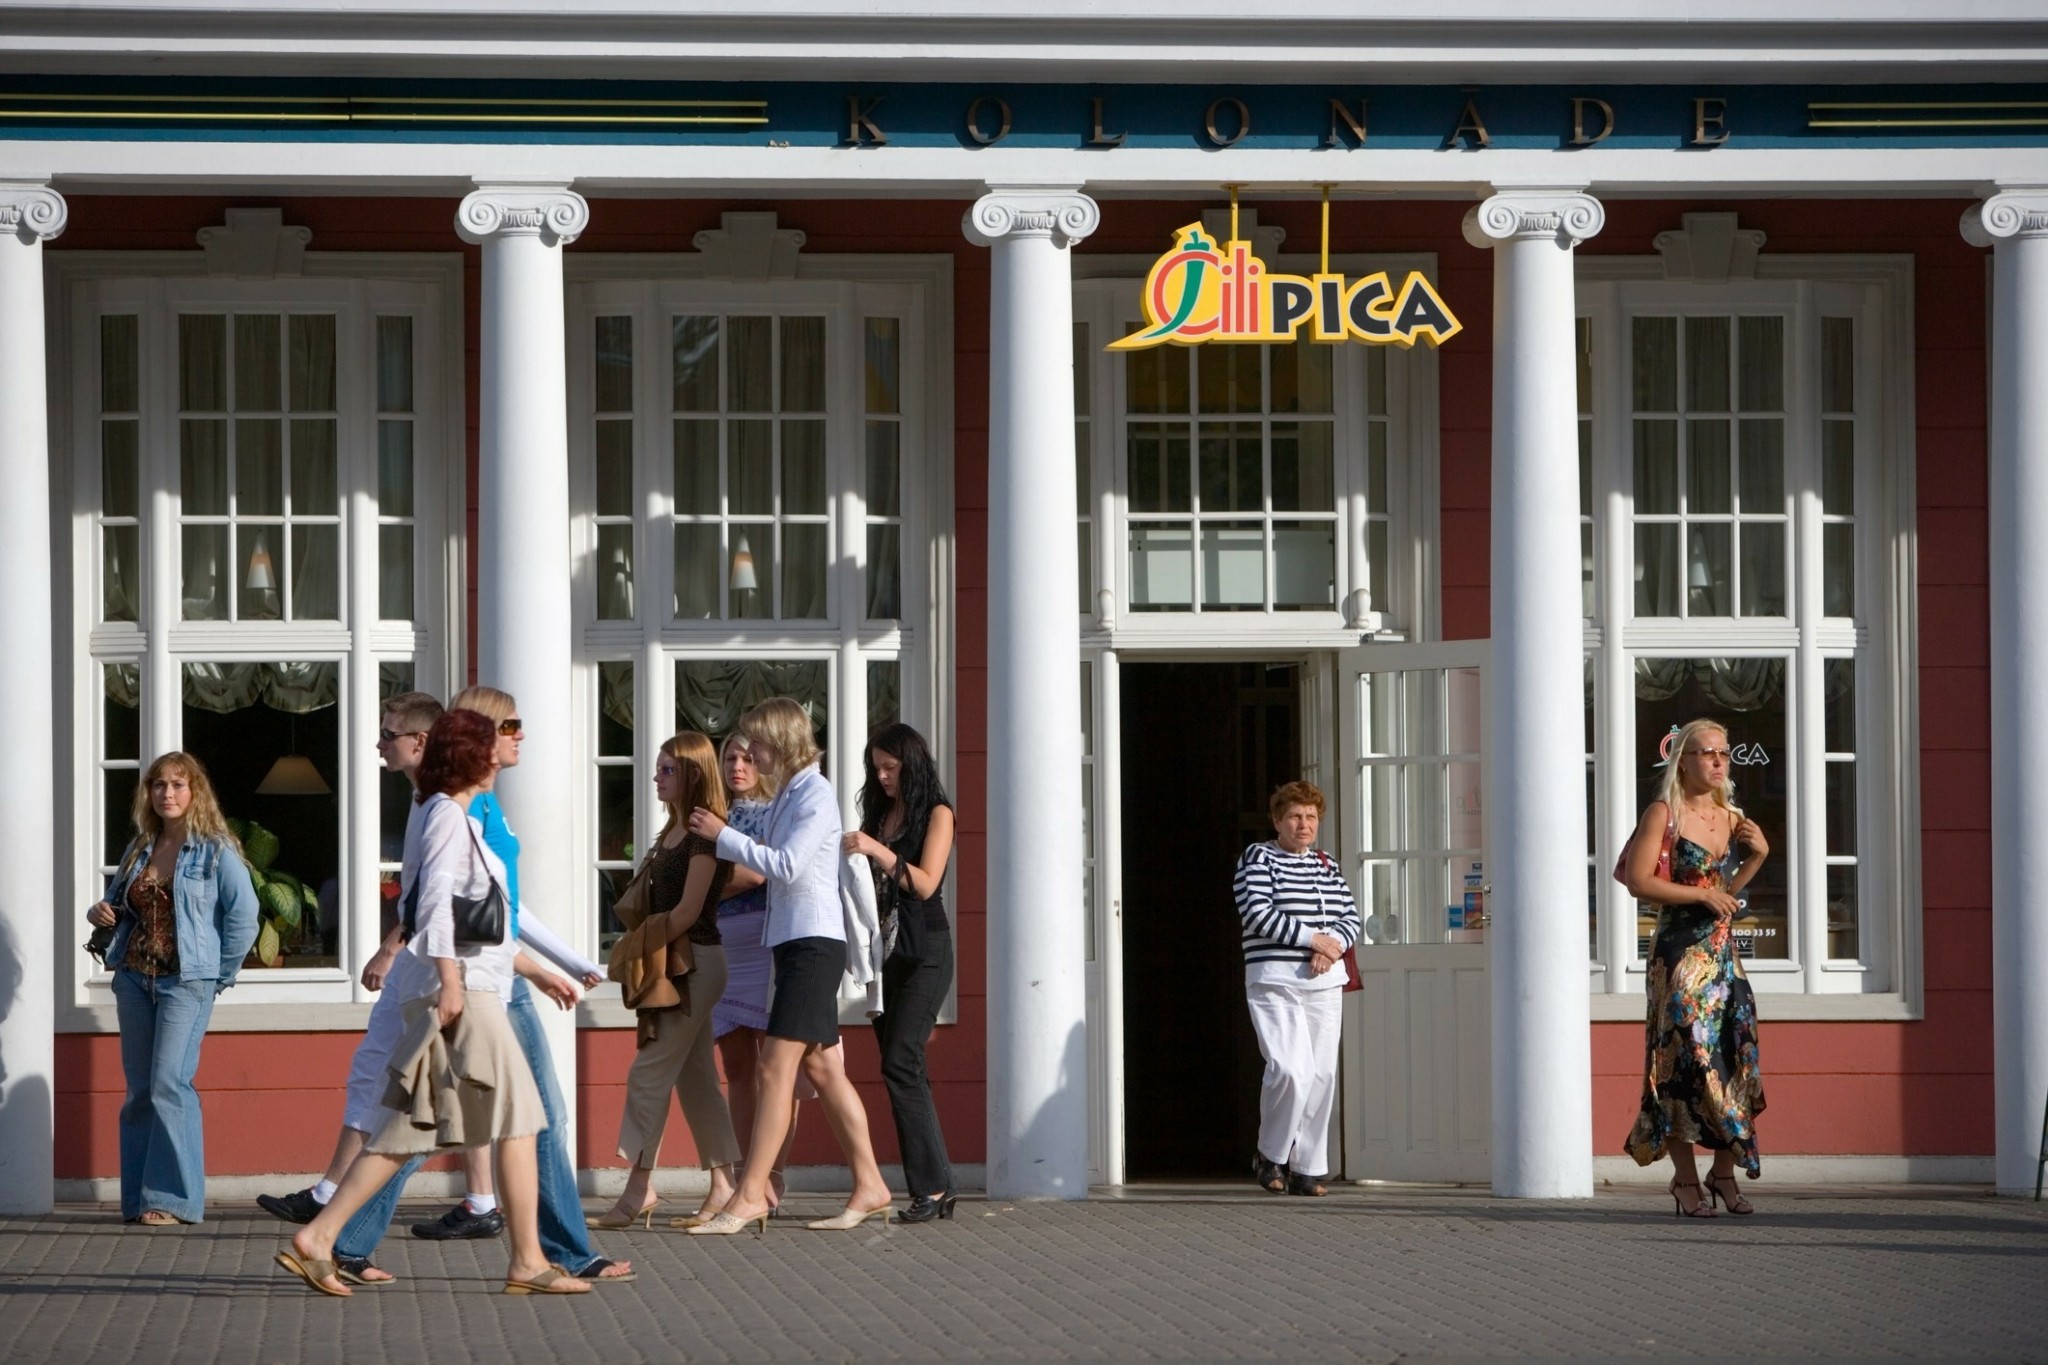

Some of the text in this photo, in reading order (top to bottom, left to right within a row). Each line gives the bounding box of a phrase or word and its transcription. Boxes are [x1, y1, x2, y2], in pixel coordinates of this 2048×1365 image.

[1272, 280, 1454, 336] PICA
[1727, 742, 1770, 765] CA
[1753, 928, 1763, 937] 33
[1765, 928, 1776, 937] 55
